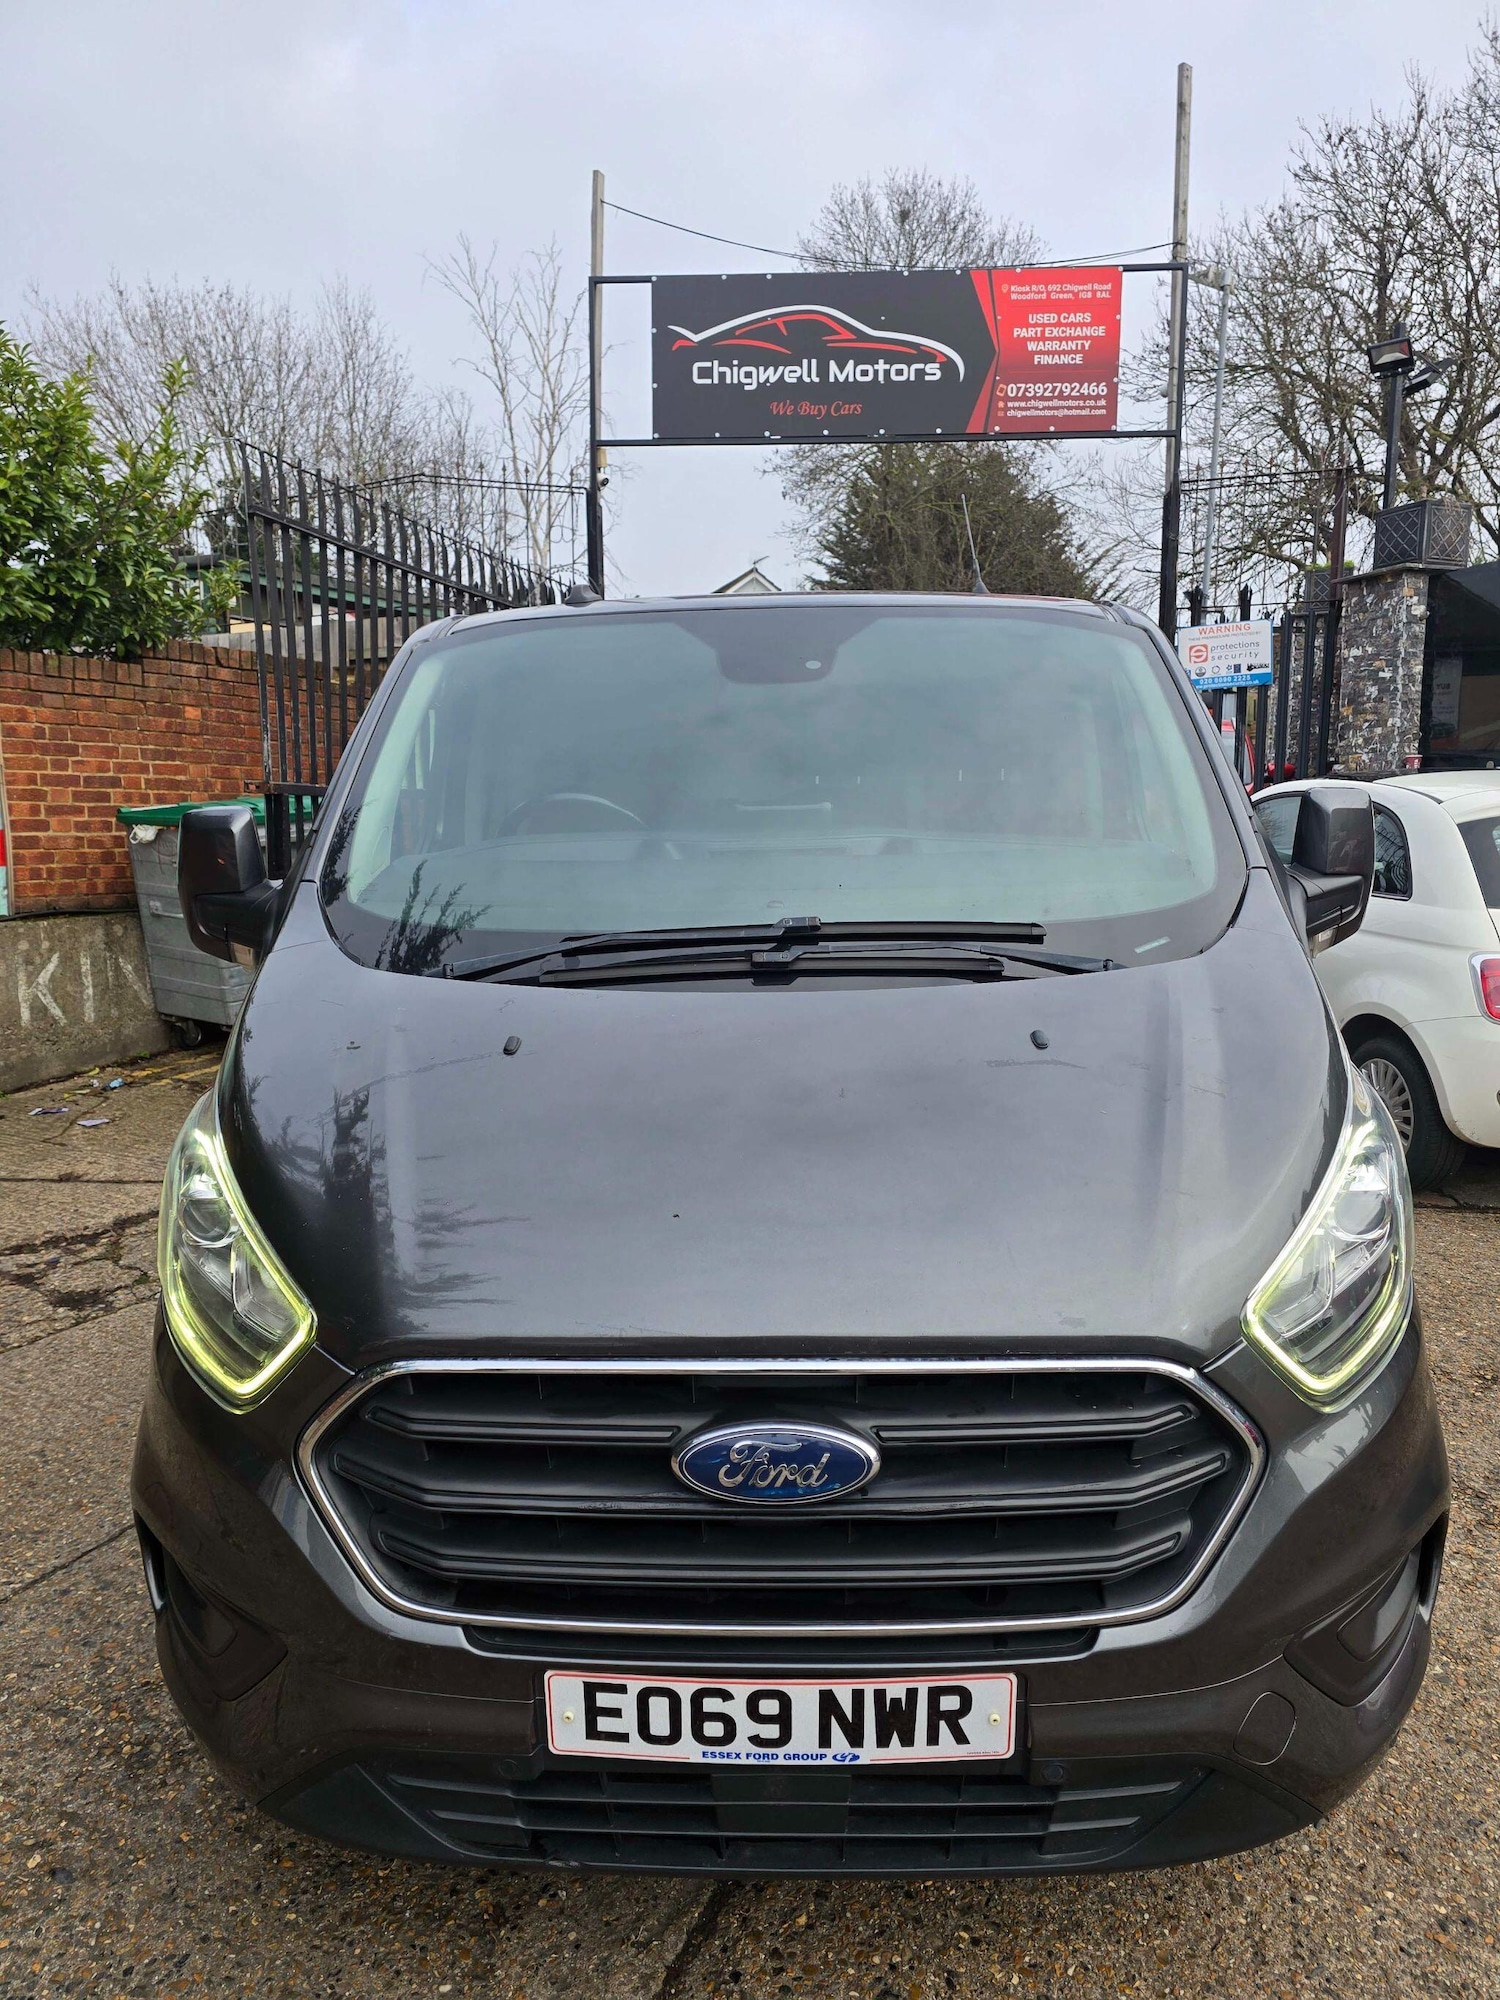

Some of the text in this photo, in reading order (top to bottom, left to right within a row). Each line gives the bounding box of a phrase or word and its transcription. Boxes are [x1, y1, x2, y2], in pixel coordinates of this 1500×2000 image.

[1062, 282, 1092, 292] Chigwell
[1094, 282, 1112, 290] Road
[1011, 292, 1046, 300] Woodford
[1028, 312, 1092, 324] USED CARS
[1014, 326, 1106, 338] PART EXCHANGE
[1027, 340, 1091, 352] WARRANTY
[1034, 354, 1083, 365] FINANCE
[692, 359, 942, 391] Chigwell Motors
[1007, 382, 1108, 397] 07392792466
[1007, 398, 1106, 408] www.chigwellmotors.co.uk
[770, 400, 862, 420] We Buy Cars
[1007, 408, 1106, 418] chigwellmotors@hotmail.com
[1198, 623, 1251, 636] WARNING
[1210, 641, 1260, 653] protections
[1210, 651, 1259, 662] security
[718, 1440, 831, 1488] Ford
[582, 1680, 973, 1749] EO69 NWR
[702, 1751, 828, 1761] ESSEX FORD GROUP
